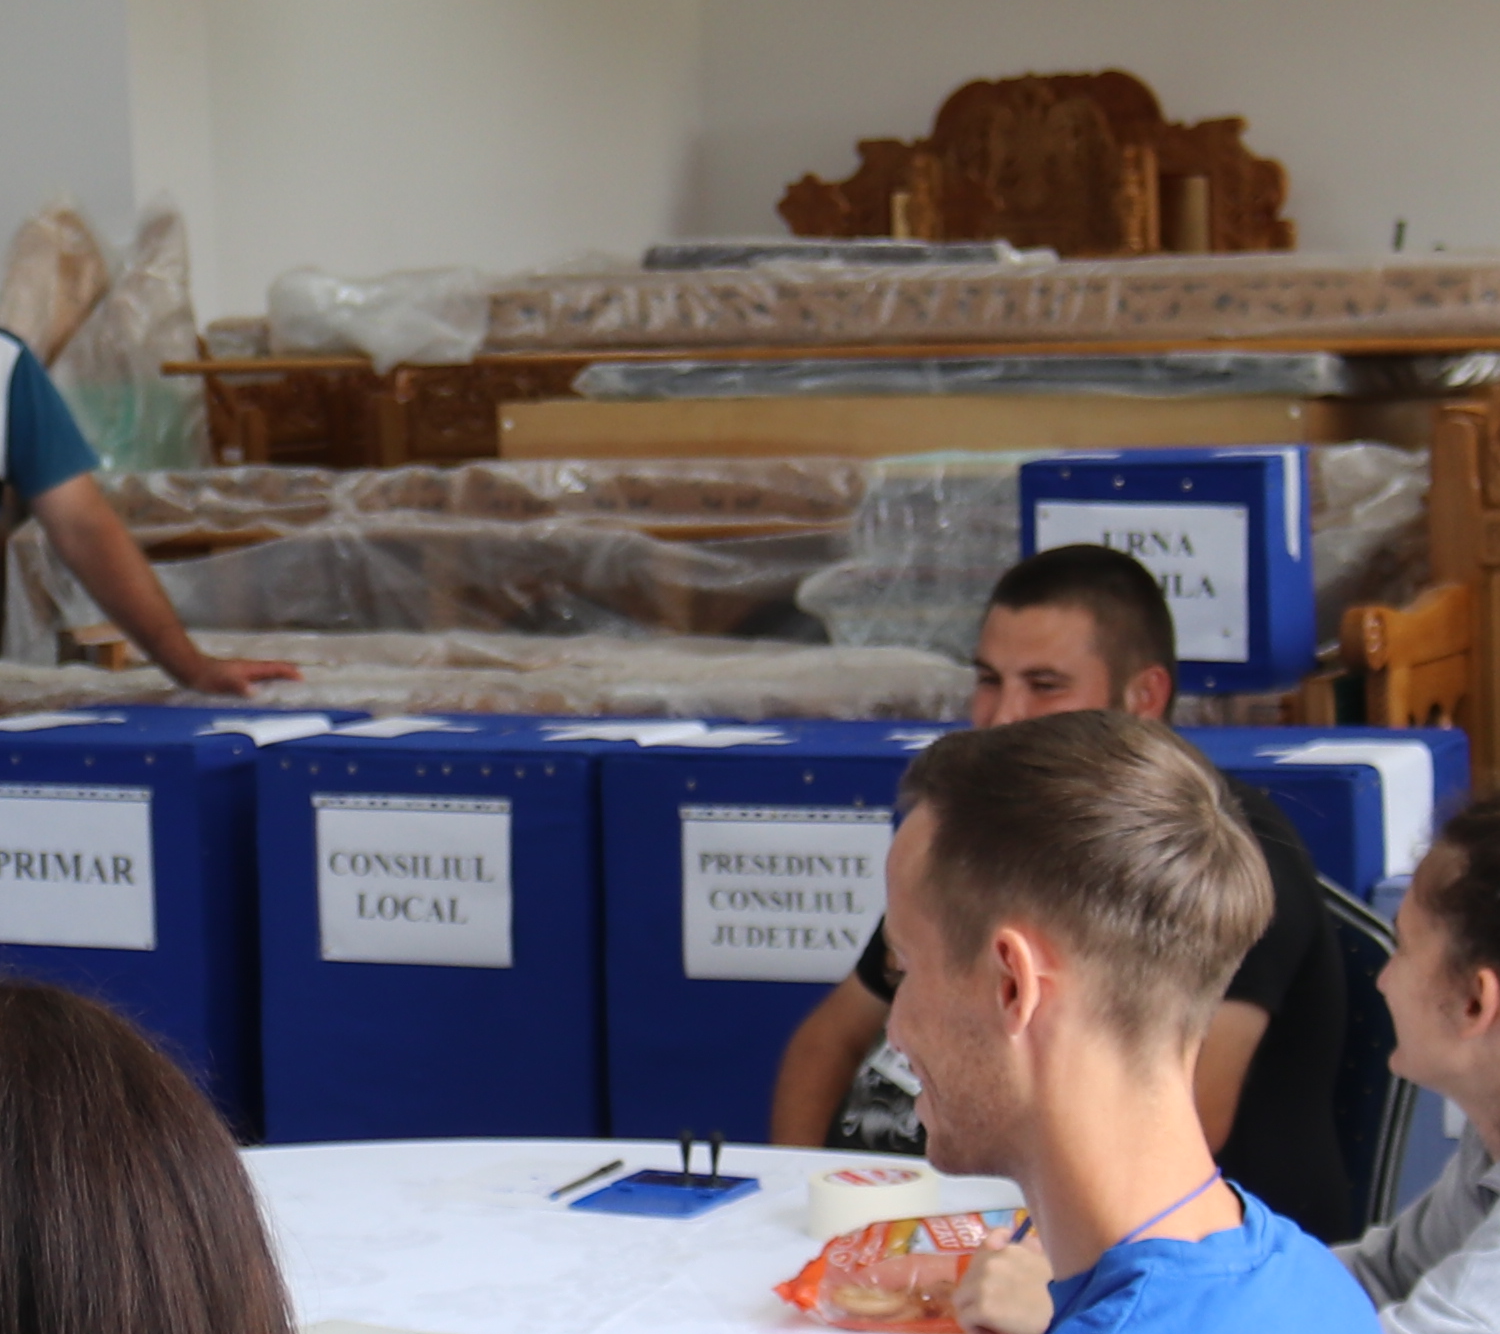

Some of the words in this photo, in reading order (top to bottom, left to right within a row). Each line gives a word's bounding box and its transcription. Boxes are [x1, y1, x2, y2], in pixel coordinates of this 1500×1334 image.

[328, 851, 496, 884] CONSILIUL
[698, 851, 874, 880] PRESEDINTE
[355, 890, 469, 926] LOCAL
[708, 889, 866, 915] CONSILIUL
[709, 923, 860, 952] JUDETEAN
